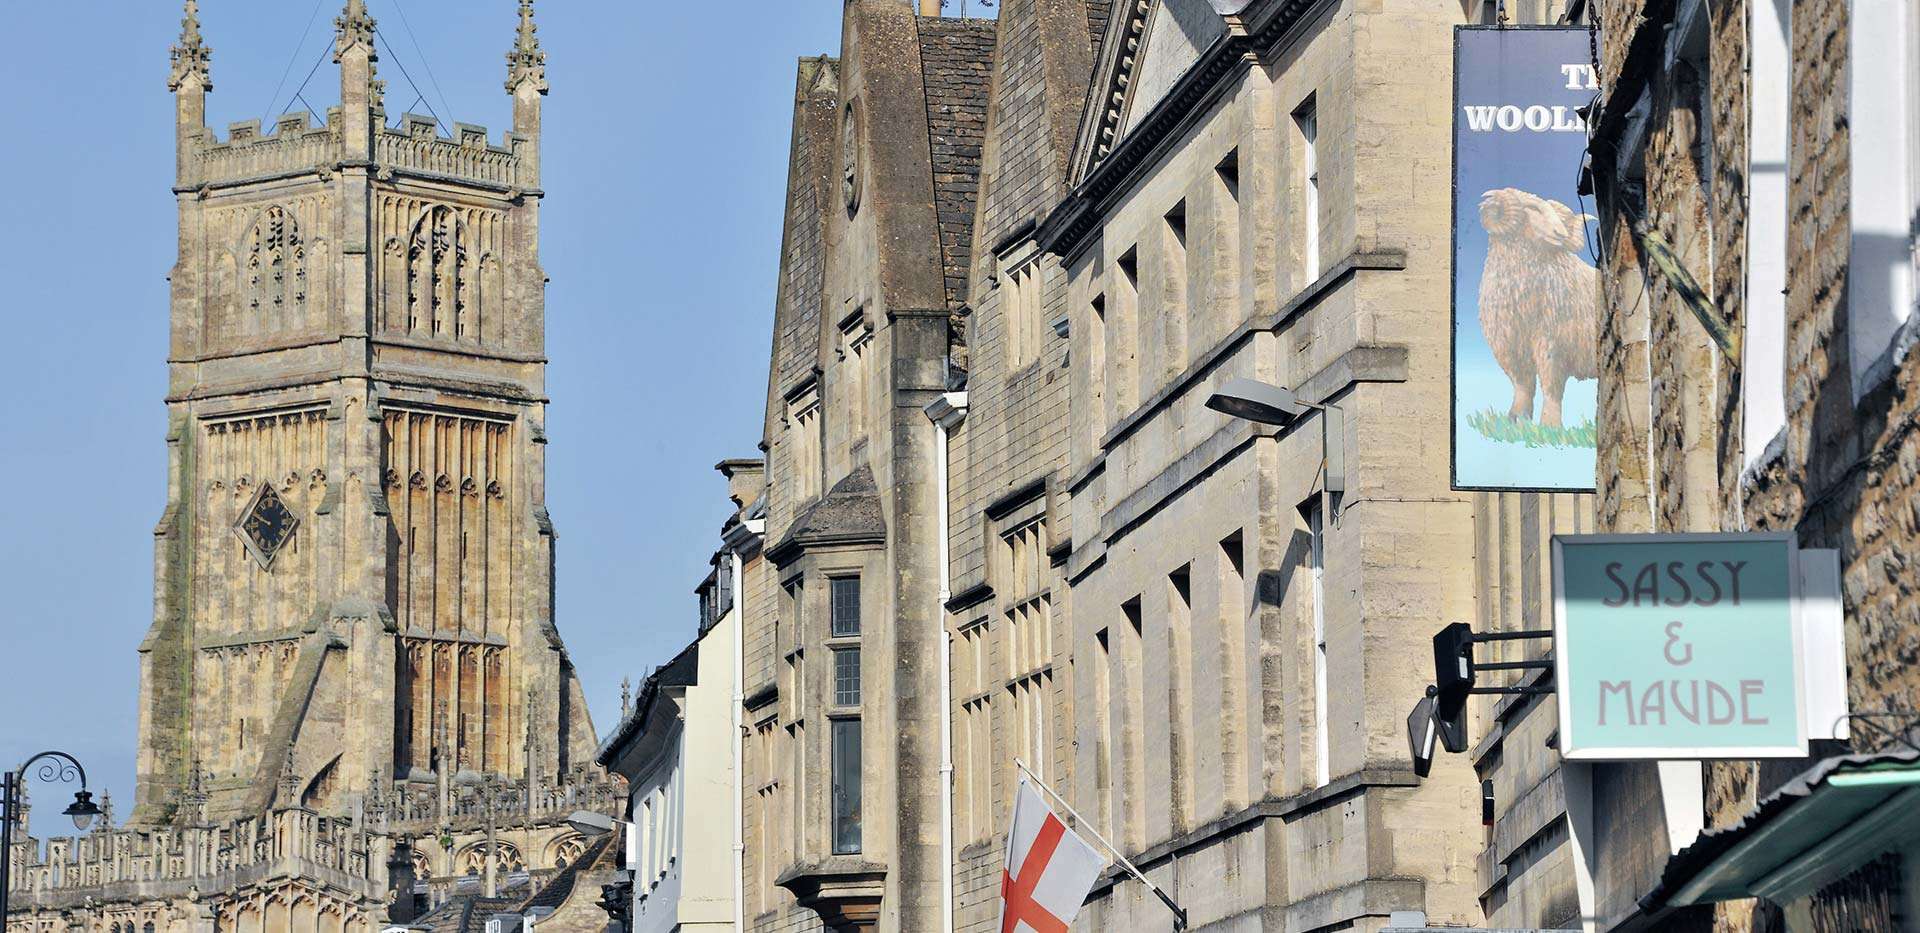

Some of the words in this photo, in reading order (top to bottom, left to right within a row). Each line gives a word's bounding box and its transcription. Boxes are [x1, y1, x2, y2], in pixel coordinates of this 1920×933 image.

[1602, 561, 1748, 607] SASSY
[1663, 621, 1693, 666] &
[1597, 679, 1769, 726] MAUDE
